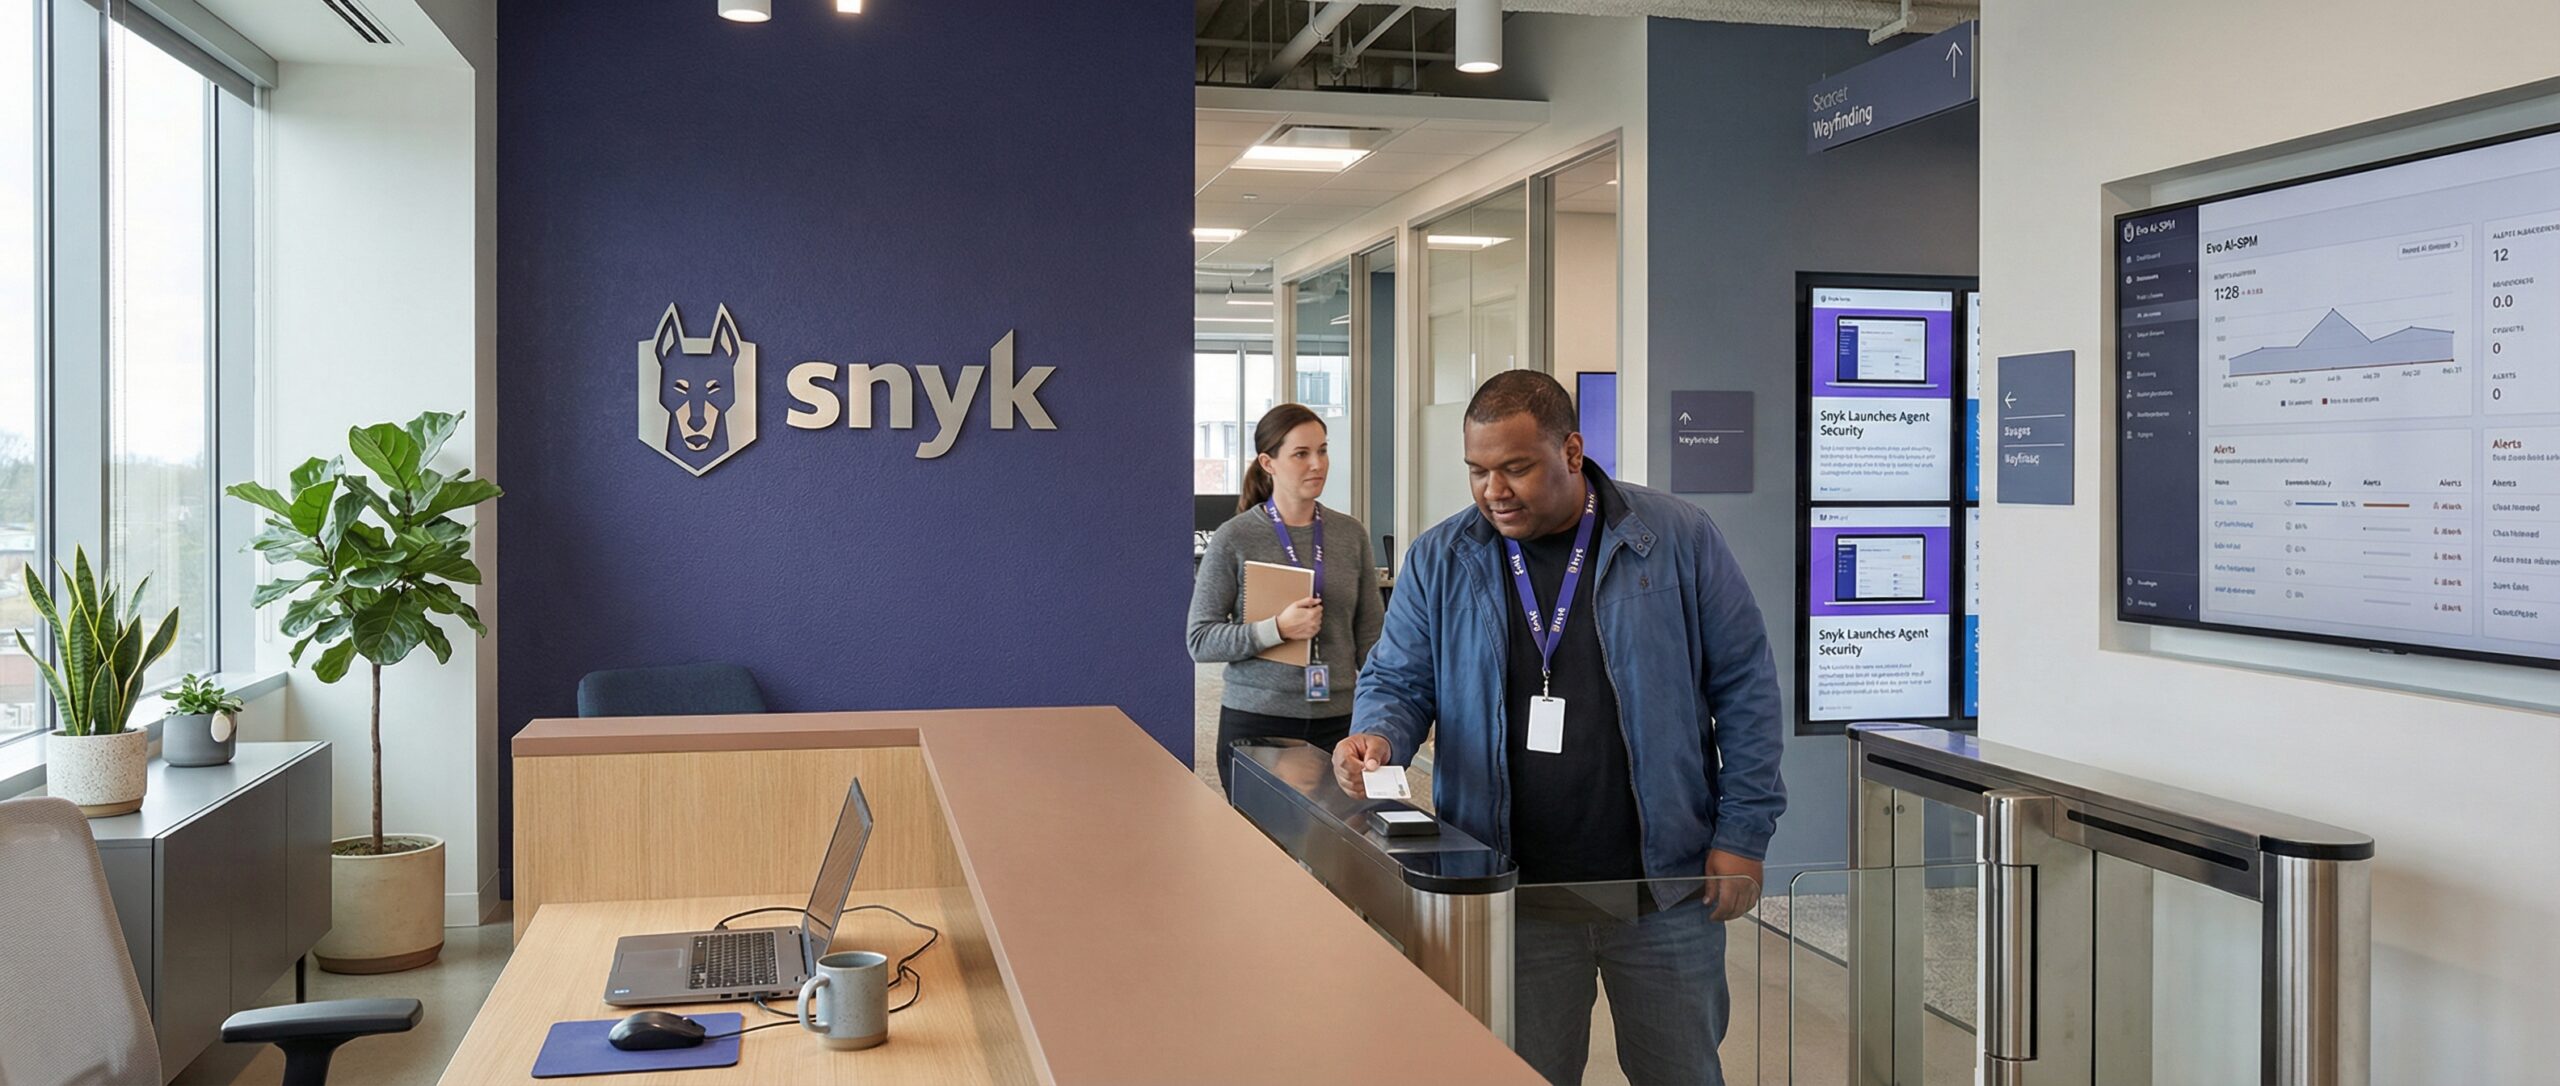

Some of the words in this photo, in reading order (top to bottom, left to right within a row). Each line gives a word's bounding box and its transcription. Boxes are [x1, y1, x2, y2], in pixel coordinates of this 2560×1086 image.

[1812, 105, 1873, 140] Wayfinding
[2206, 243, 2223, 254] Evo
[2224, 235, 2258, 252] AI-SPM
[2493, 248, 2509, 262] 12
[2214, 285, 2240, 301] 1:28
[2492, 294, 2514, 309] 0.0
[2492, 342, 2501, 354] 0
[786, 328, 1058, 460] snyk
[2492, 388, 2501, 401] 0
[1820, 410, 1846, 425] Snyk
[1848, 410, 1897, 422] Launches
[1899, 411, 1930, 425] Agent
[1820, 424, 1864, 439] Security
[2492, 439, 2522, 449] Alerts
[1819, 628, 1846, 643] Snyk
[1847, 627, 1896, 640] Launches
[1898, 628, 1929, 641] Agent
[1819, 643, 1862, 657] Security
